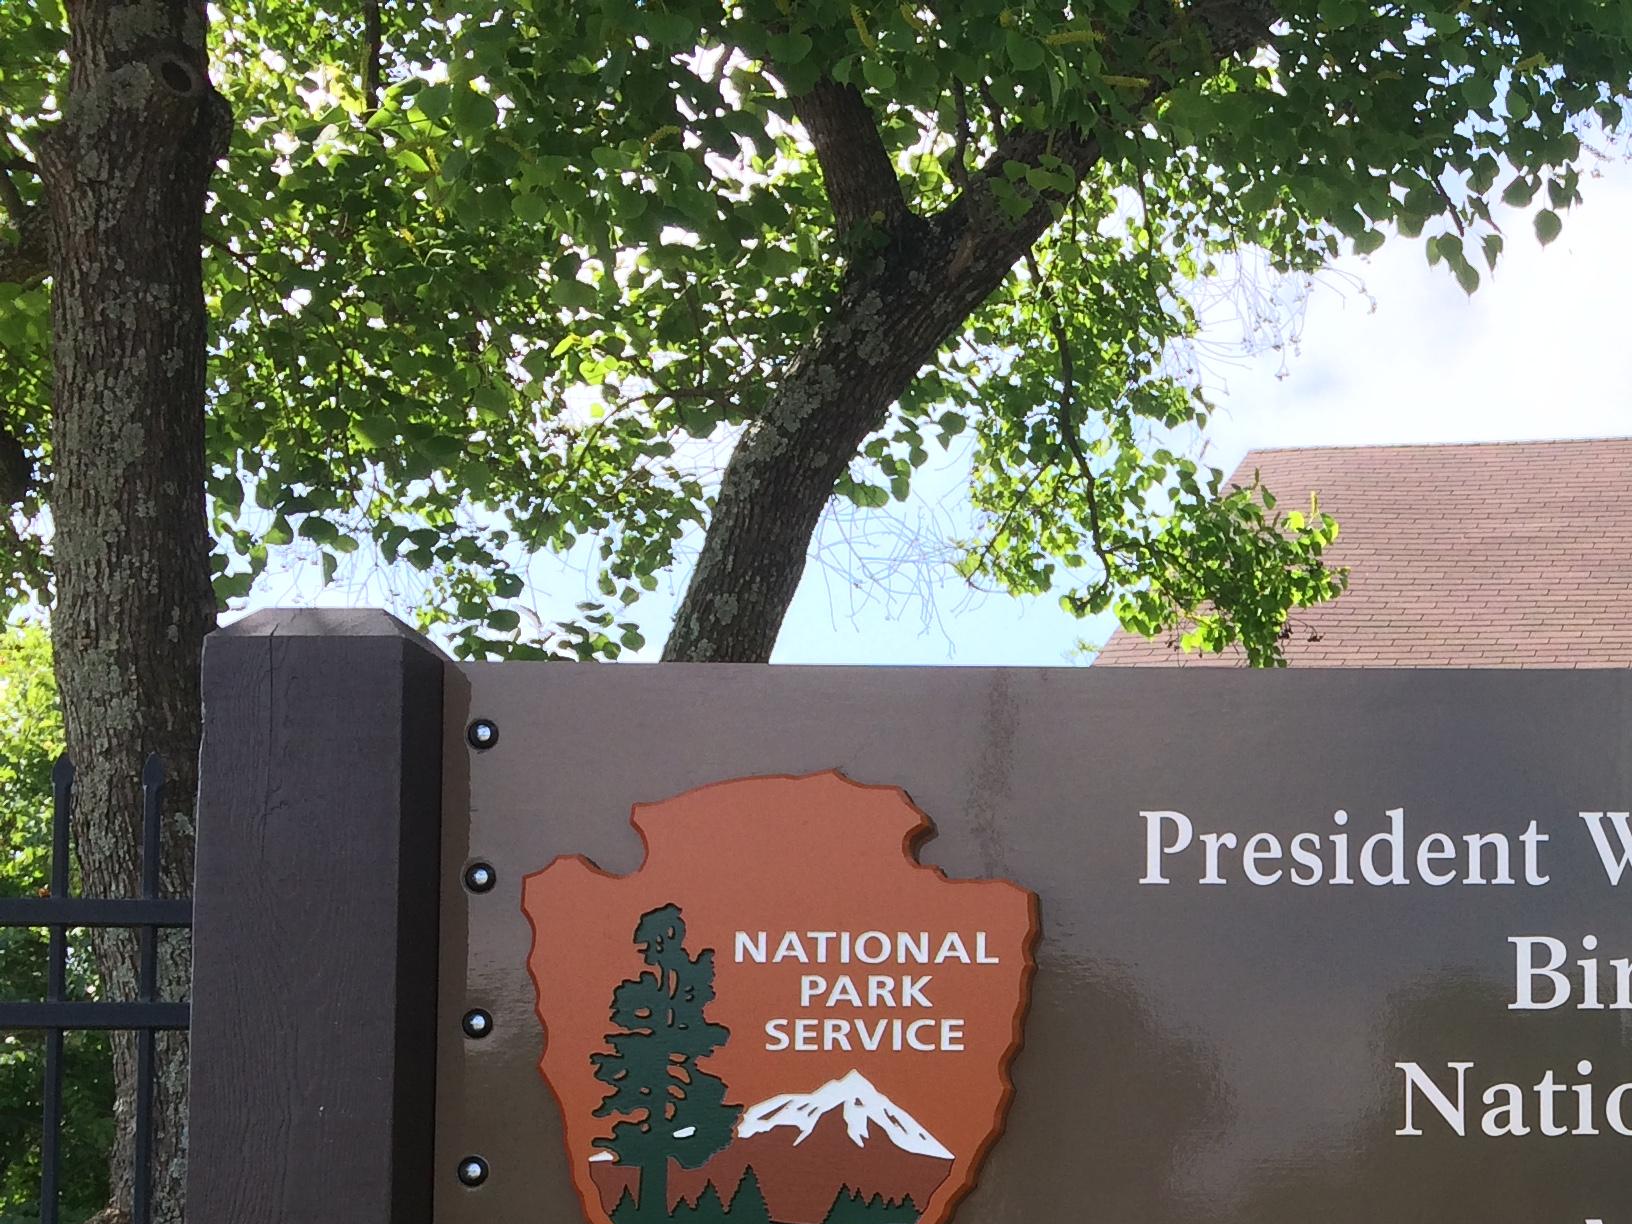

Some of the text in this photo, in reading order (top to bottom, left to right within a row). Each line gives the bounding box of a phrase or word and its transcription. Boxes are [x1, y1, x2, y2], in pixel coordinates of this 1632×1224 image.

[1139, 808, 1549, 888] President
[734, 931, 999, 964] NATIONAL
[800, 975, 932, 1007] PARK
[764, 1018, 965, 1051] SERVICE
